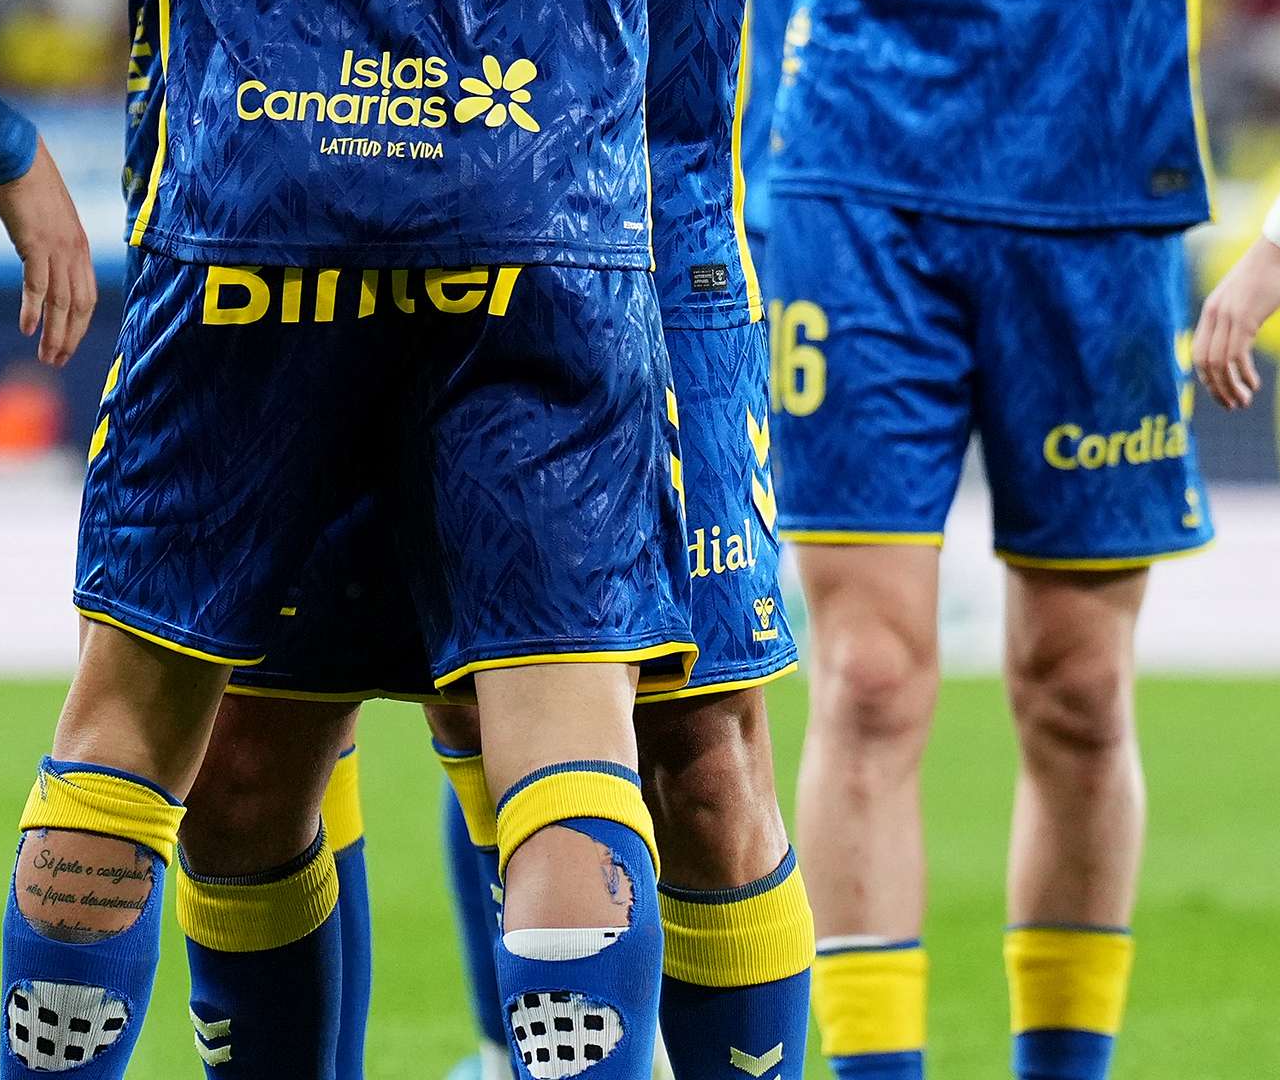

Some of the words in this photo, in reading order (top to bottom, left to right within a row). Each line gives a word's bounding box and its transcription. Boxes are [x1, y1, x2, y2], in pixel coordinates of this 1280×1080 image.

[339, 49, 449, 89] Islas
[236, 79, 448, 128] Canarias
[320, 137, 382, 157] LATITUD
[387, 141, 407, 157] DE
[410, 141, 444, 160] VIDA
[769, 299, 828, 417] 16
[1043, 414, 1189, 470] Cordia
[687, 518, 757, 579] dial
